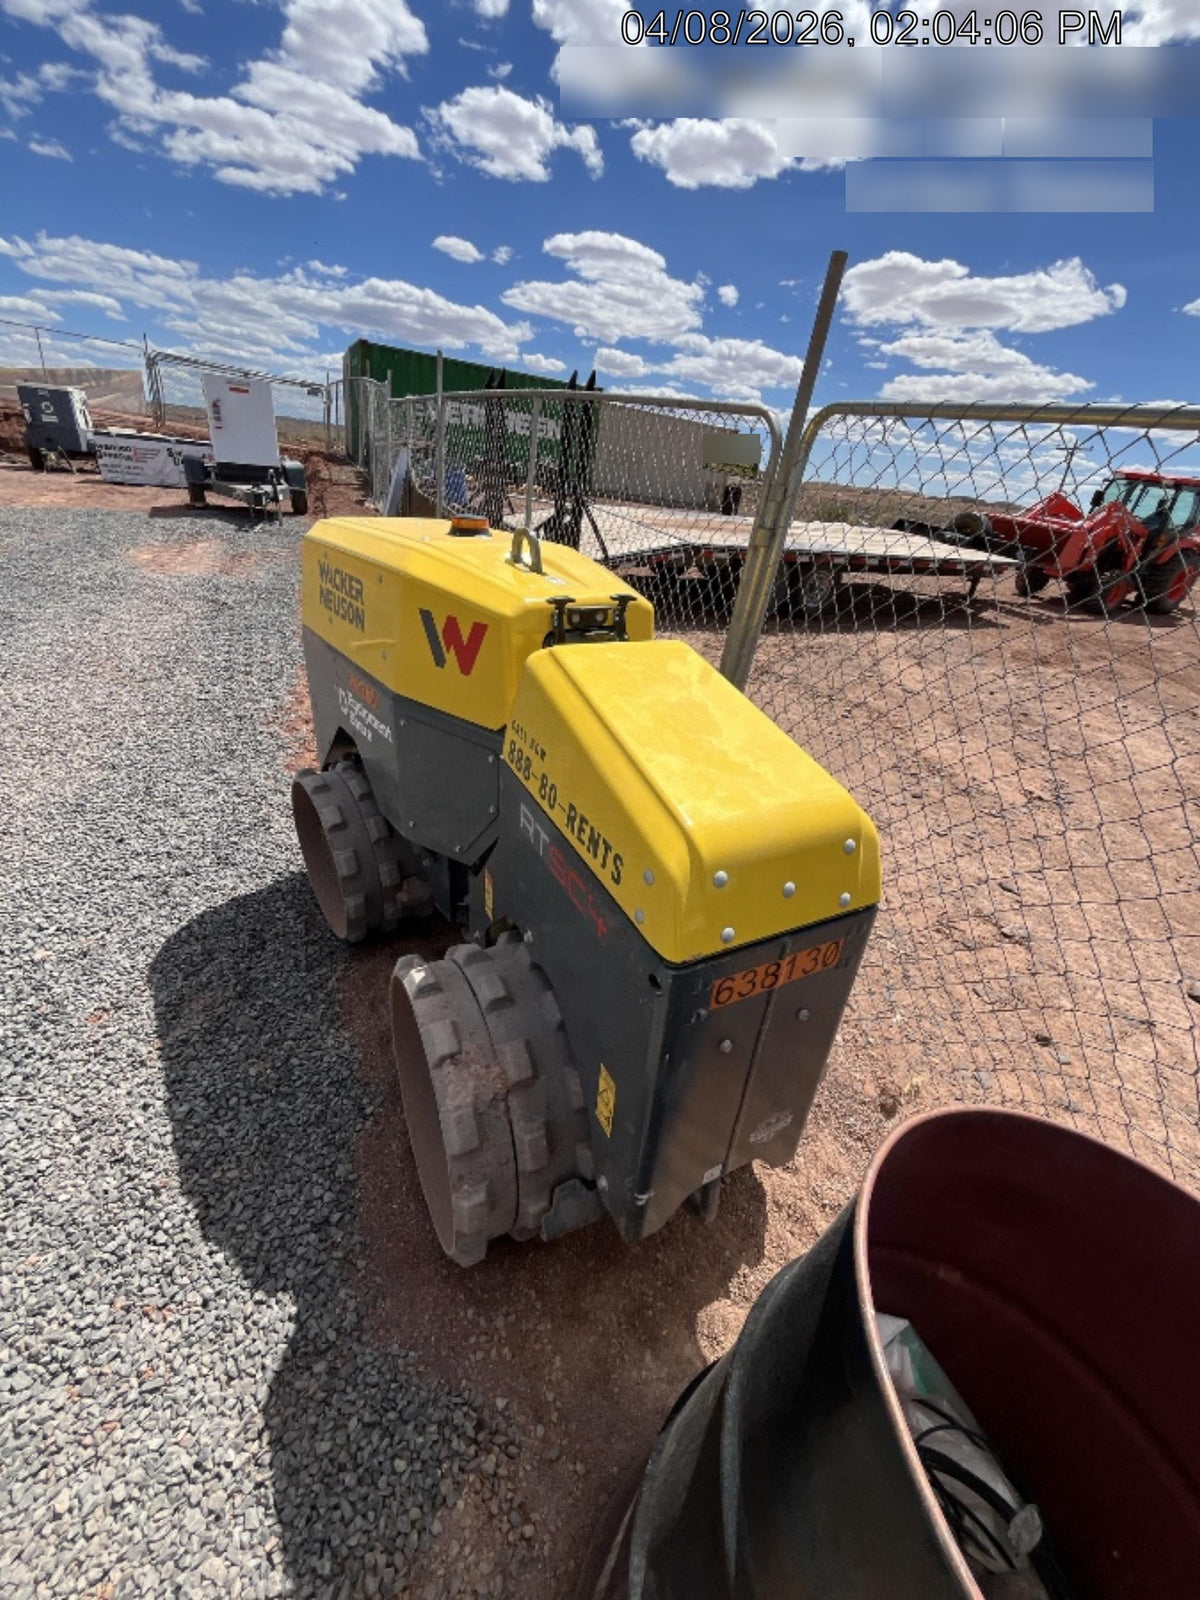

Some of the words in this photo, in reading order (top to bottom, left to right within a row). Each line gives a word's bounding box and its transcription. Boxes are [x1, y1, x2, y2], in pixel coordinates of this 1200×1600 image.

[318, 560, 365, 607] WACKER
[319, 584, 366, 633] NEUSON
[508, 739, 624, 886] 888-80-RENTS
[713, 941, 842, 1006] 638130
